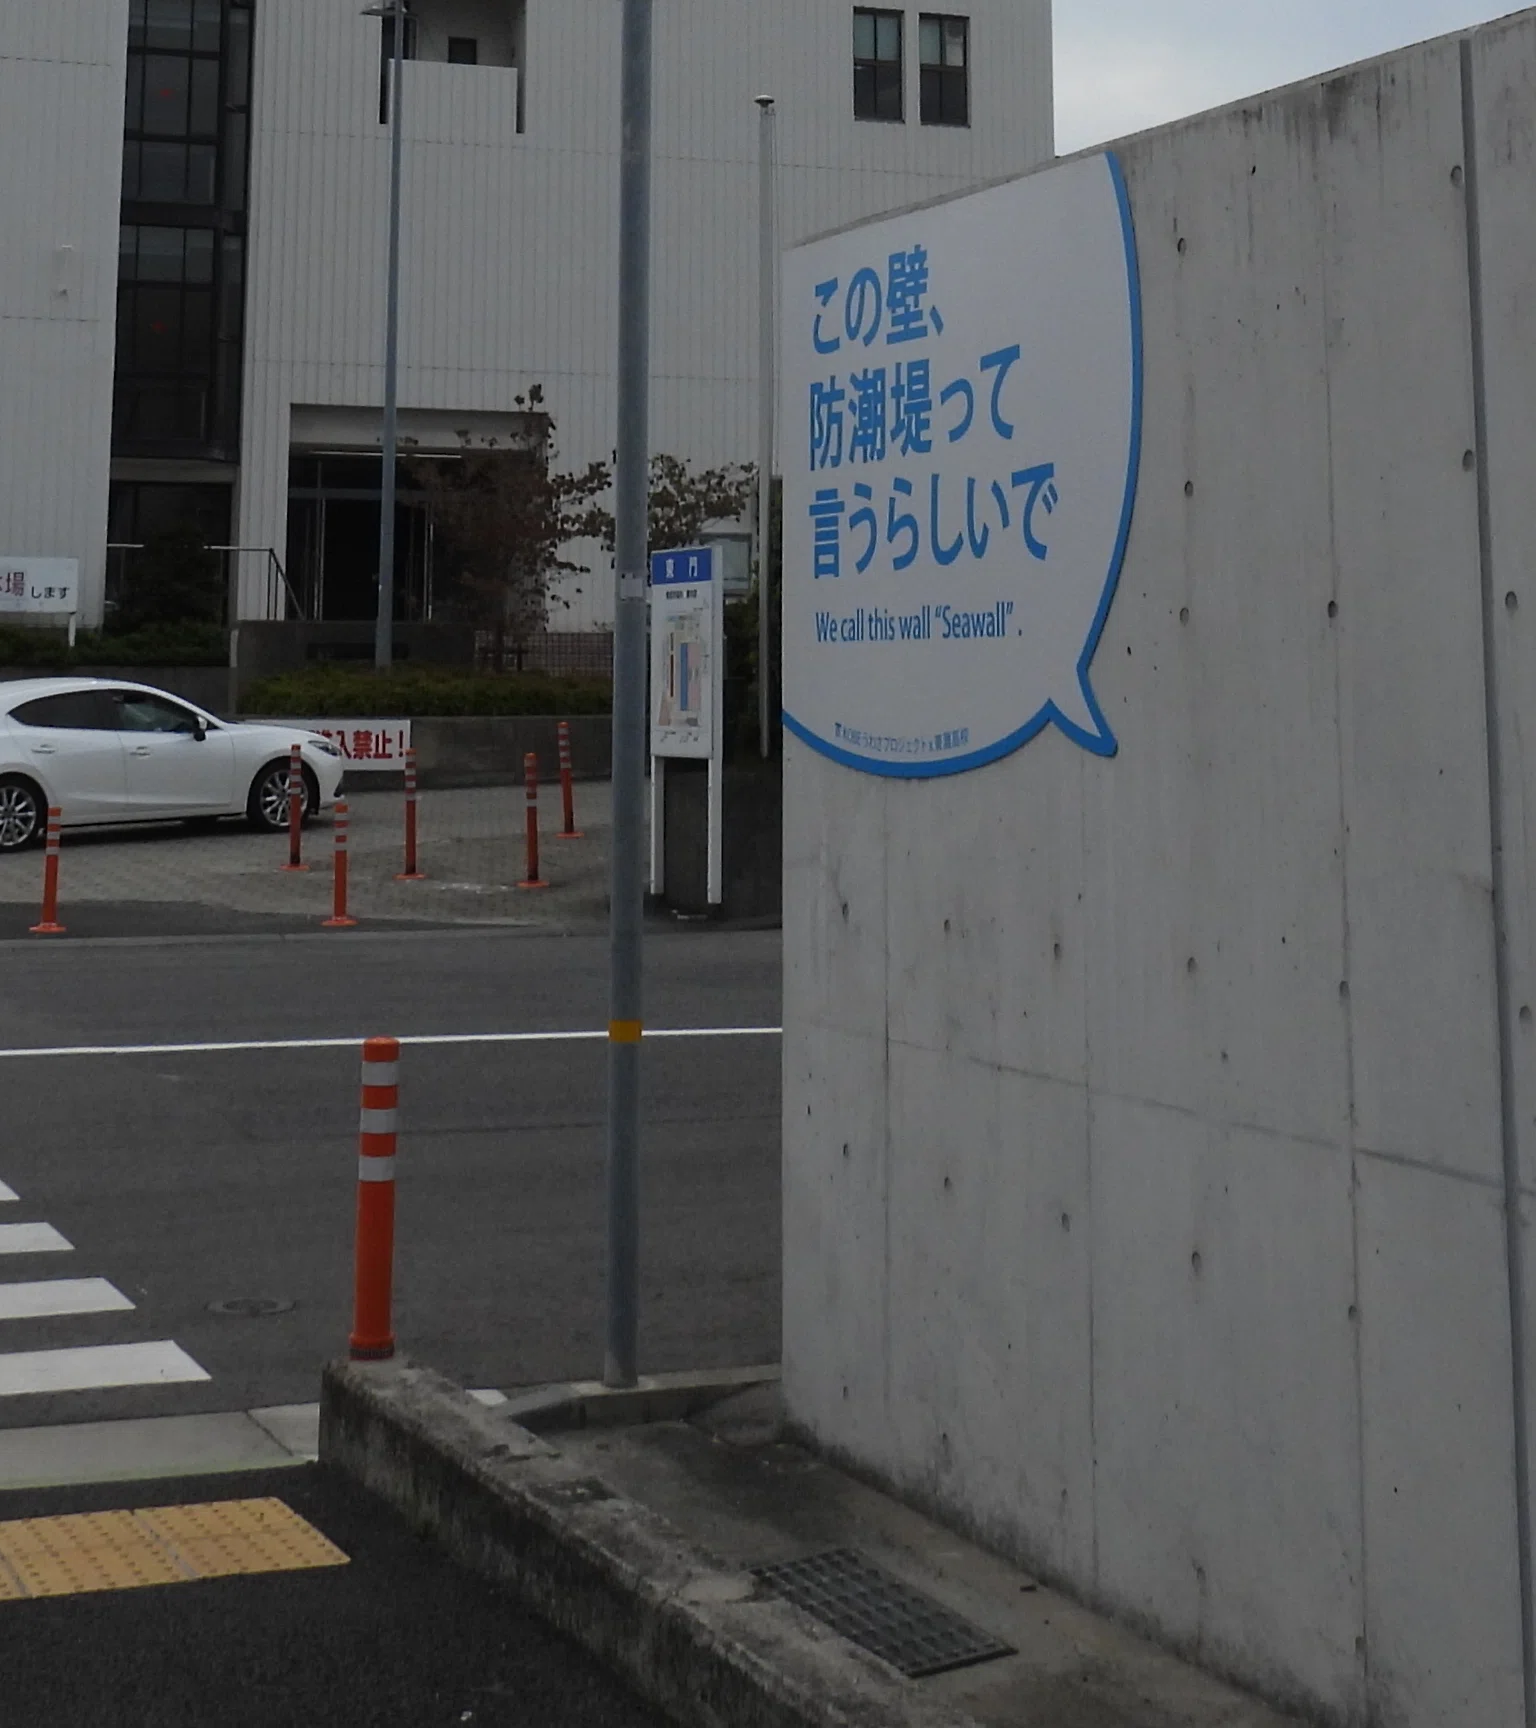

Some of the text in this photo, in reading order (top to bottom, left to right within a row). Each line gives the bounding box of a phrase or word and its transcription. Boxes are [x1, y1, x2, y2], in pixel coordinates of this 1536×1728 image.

[812, 243, 945, 355] この壁、
[809, 344, 1021, 472] 防潮堤って
[808, 462, 1059, 580] 言うらしいで
[815, 611, 838, 643] We
[840, 608, 864, 642] call
[868, 606, 895, 641] this
[898, 605, 931, 640] wall
